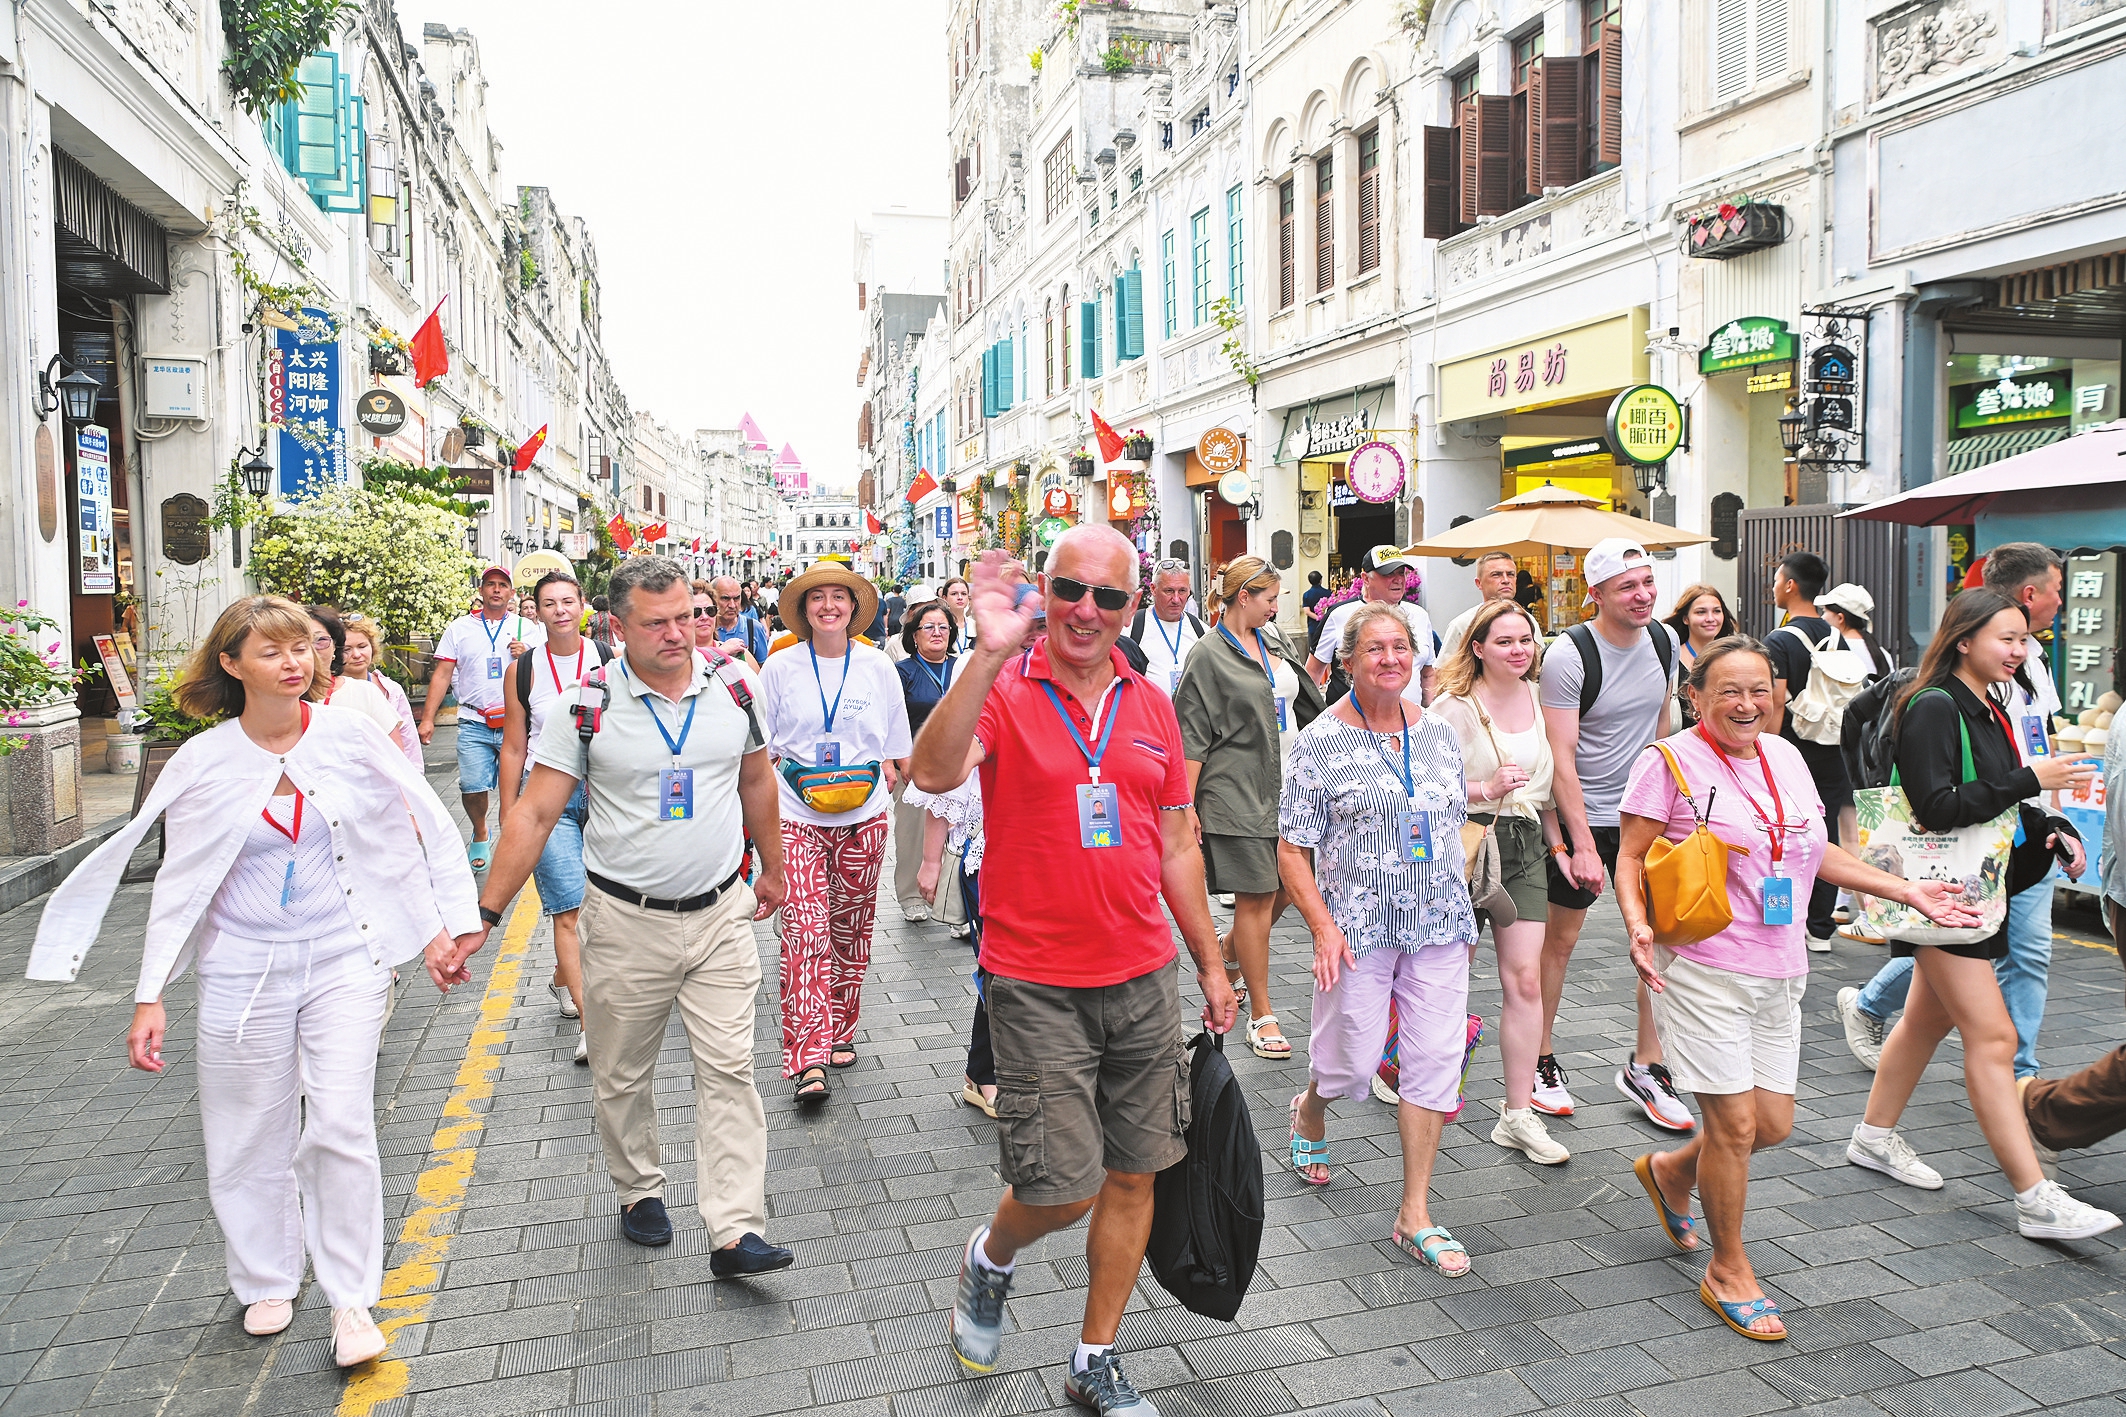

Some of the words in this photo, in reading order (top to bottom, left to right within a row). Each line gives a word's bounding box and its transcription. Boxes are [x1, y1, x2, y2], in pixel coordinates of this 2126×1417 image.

[1711, 322, 1773, 360] 叁姑娘
[153, 365, 191, 374] 龙华区政法委
[269, 348, 283, 425] 源自1952
[1488, 343, 1567, 397] 尚易坊
[309, 351, 329, 438] 兴隆咖啡
[1977, 381, 2050, 416] 叁姑娘
[1630, 408, 1667, 425] 椰香
[1629, 427, 1667, 445] 脆饼
[1372, 453, 1382, 493] 尚易坊
[1093, 831, 1111, 847] 146
